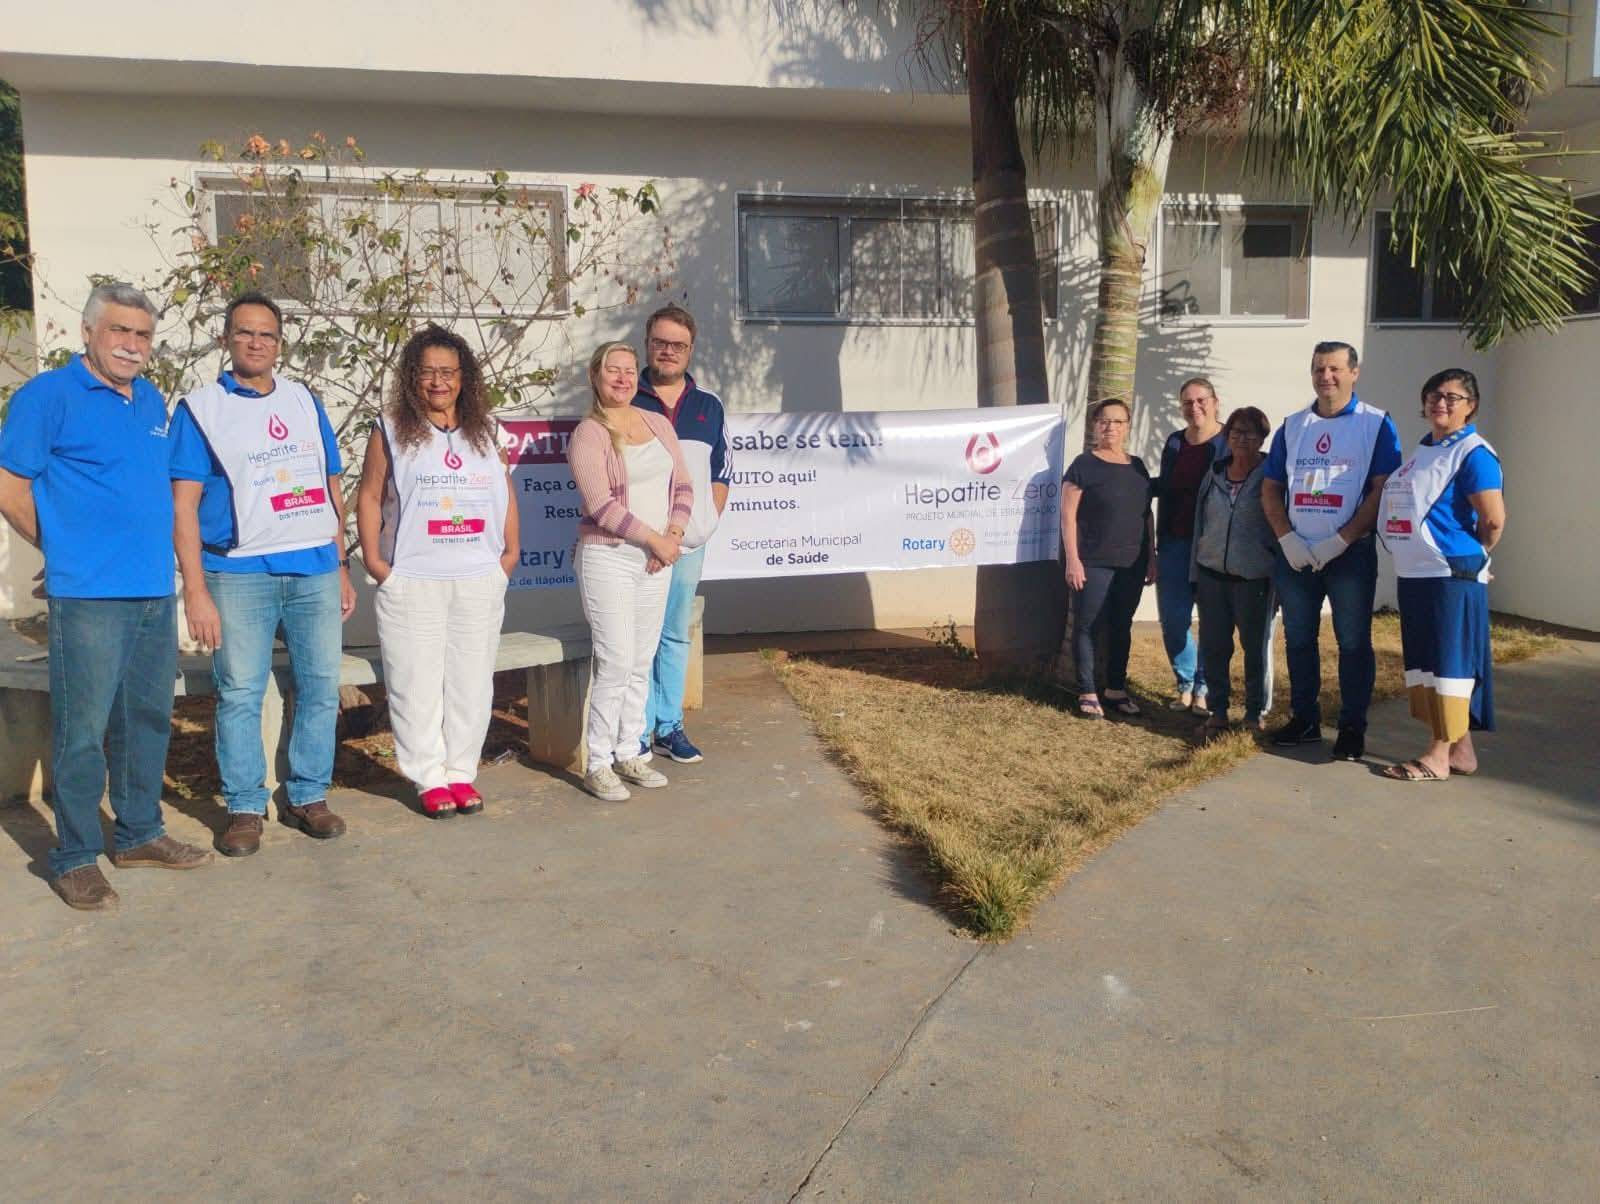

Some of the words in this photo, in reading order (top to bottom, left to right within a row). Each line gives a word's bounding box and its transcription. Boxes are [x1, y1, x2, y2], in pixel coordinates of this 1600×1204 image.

[732, 431, 788, 451] sabe
[795, 433, 820, 449] se
[247, 443, 298, 464] Hepatite
[415, 473, 467, 486] Hepatite
[523, 478, 562, 494] Faça
[778, 470, 817, 486] aqui!
[283, 495, 315, 508] BRASIL
[905, 481, 1000, 510] Hepatite
[1008, 479, 1058, 500] Zero
[730, 499, 800, 512] minutos.
[905, 511, 945, 521] PROJETO
[441, 525, 473, 534] BRASIL
[730, 536, 797, 551] Secretaria
[801, 533, 863, 548] Municipal
[902, 538, 946, 552] Rotary
[766, 554, 784, 566] de
[787, 551, 830, 565] Saúde
[519, 576, 533, 586] de
